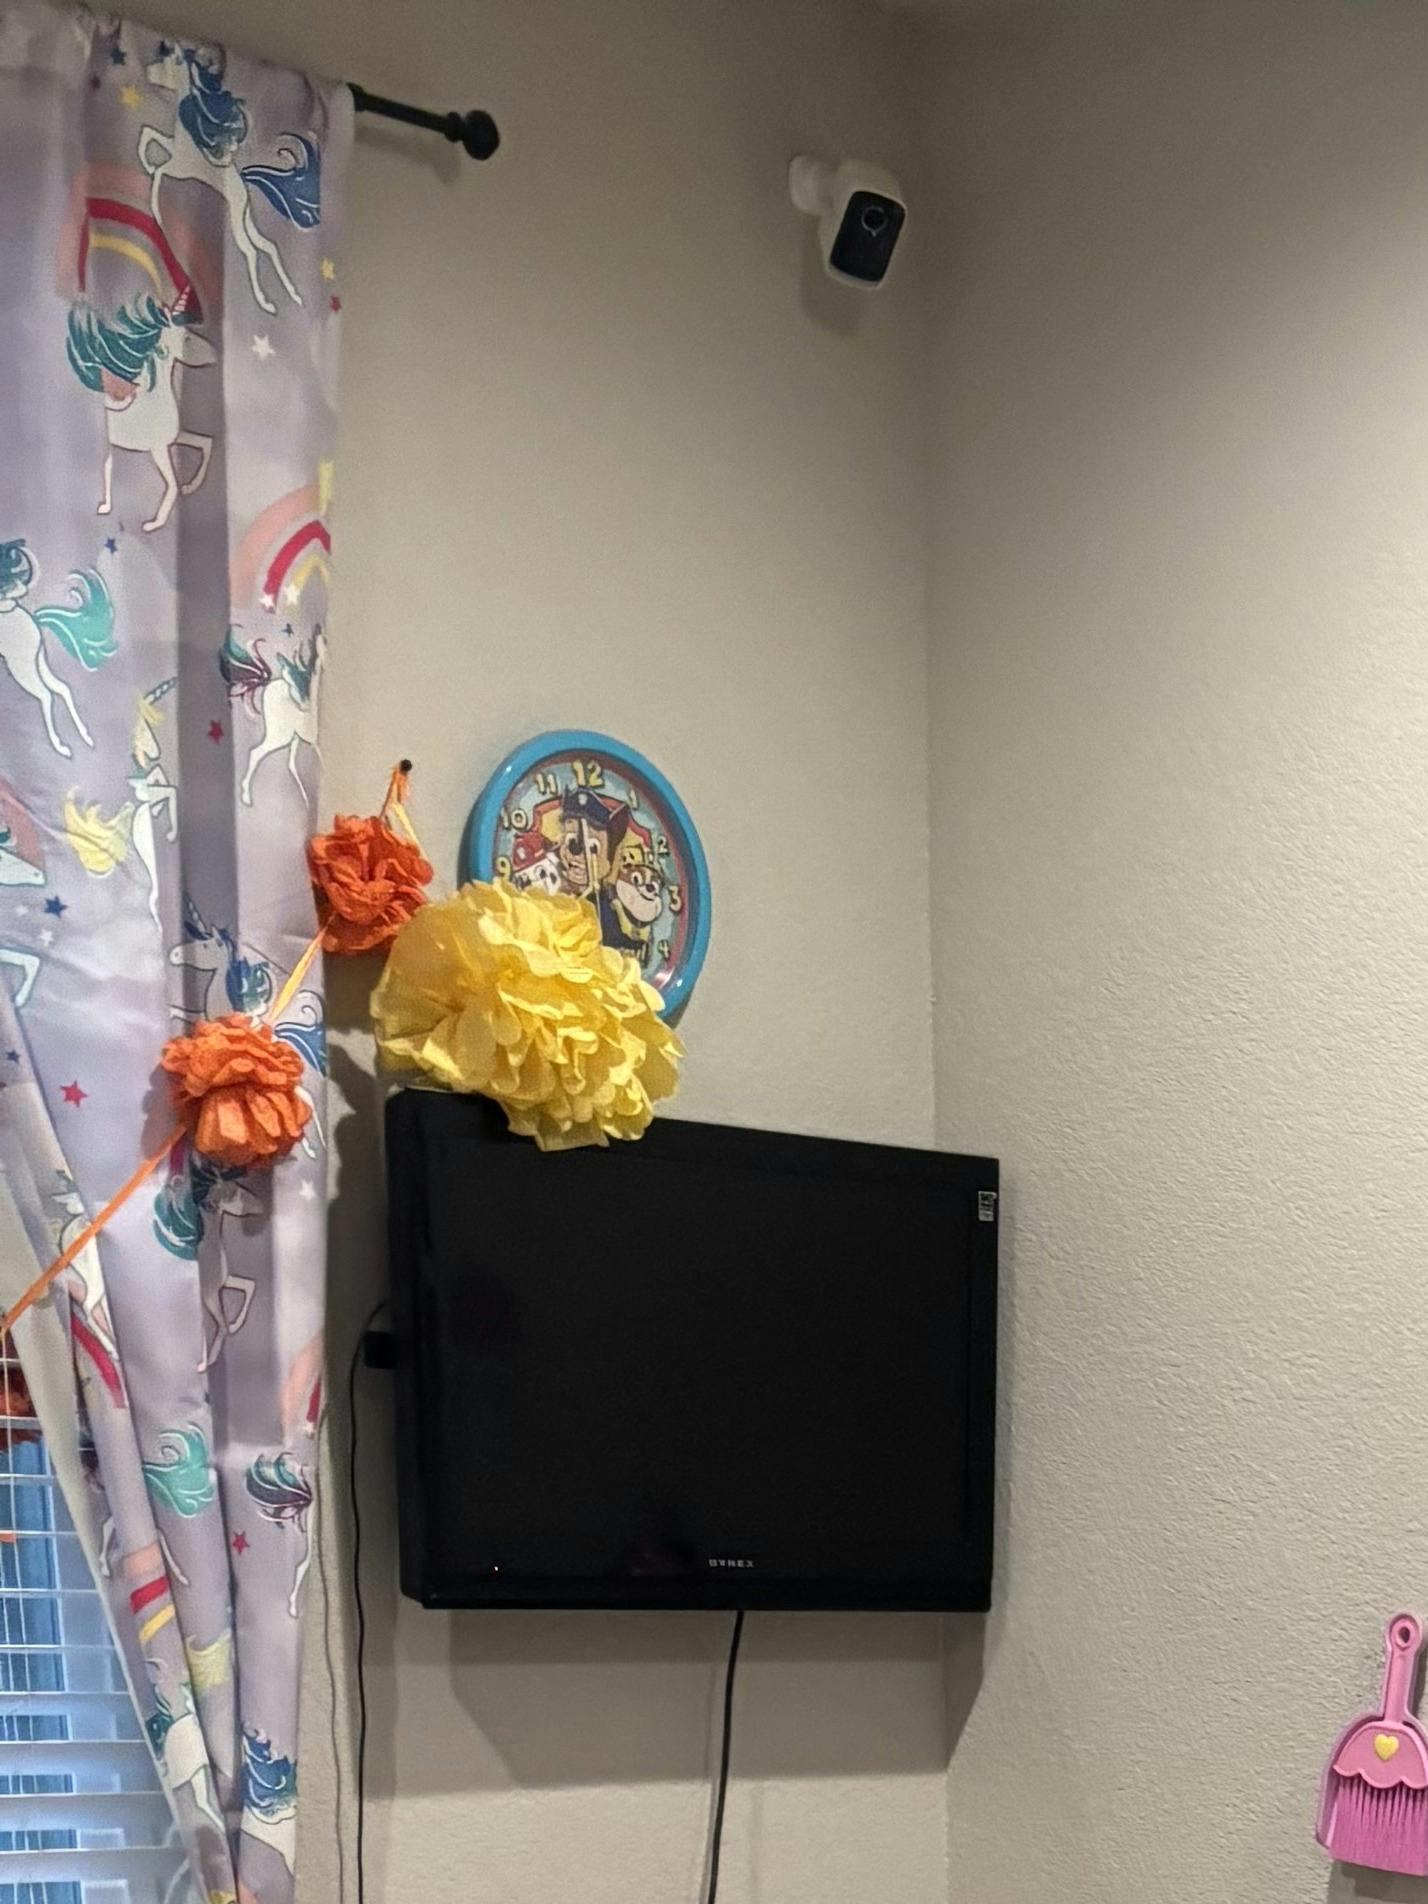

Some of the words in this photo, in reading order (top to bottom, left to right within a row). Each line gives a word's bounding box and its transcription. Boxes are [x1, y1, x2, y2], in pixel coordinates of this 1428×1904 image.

[536, 773, 557, 794] 11
[572, 760, 605, 787] 12
[502, 808, 527, 829] 10
[497, 858, 511, 878] 9
[668, 885, 682, 912] 3
[658, 940, 670, 959] 4
